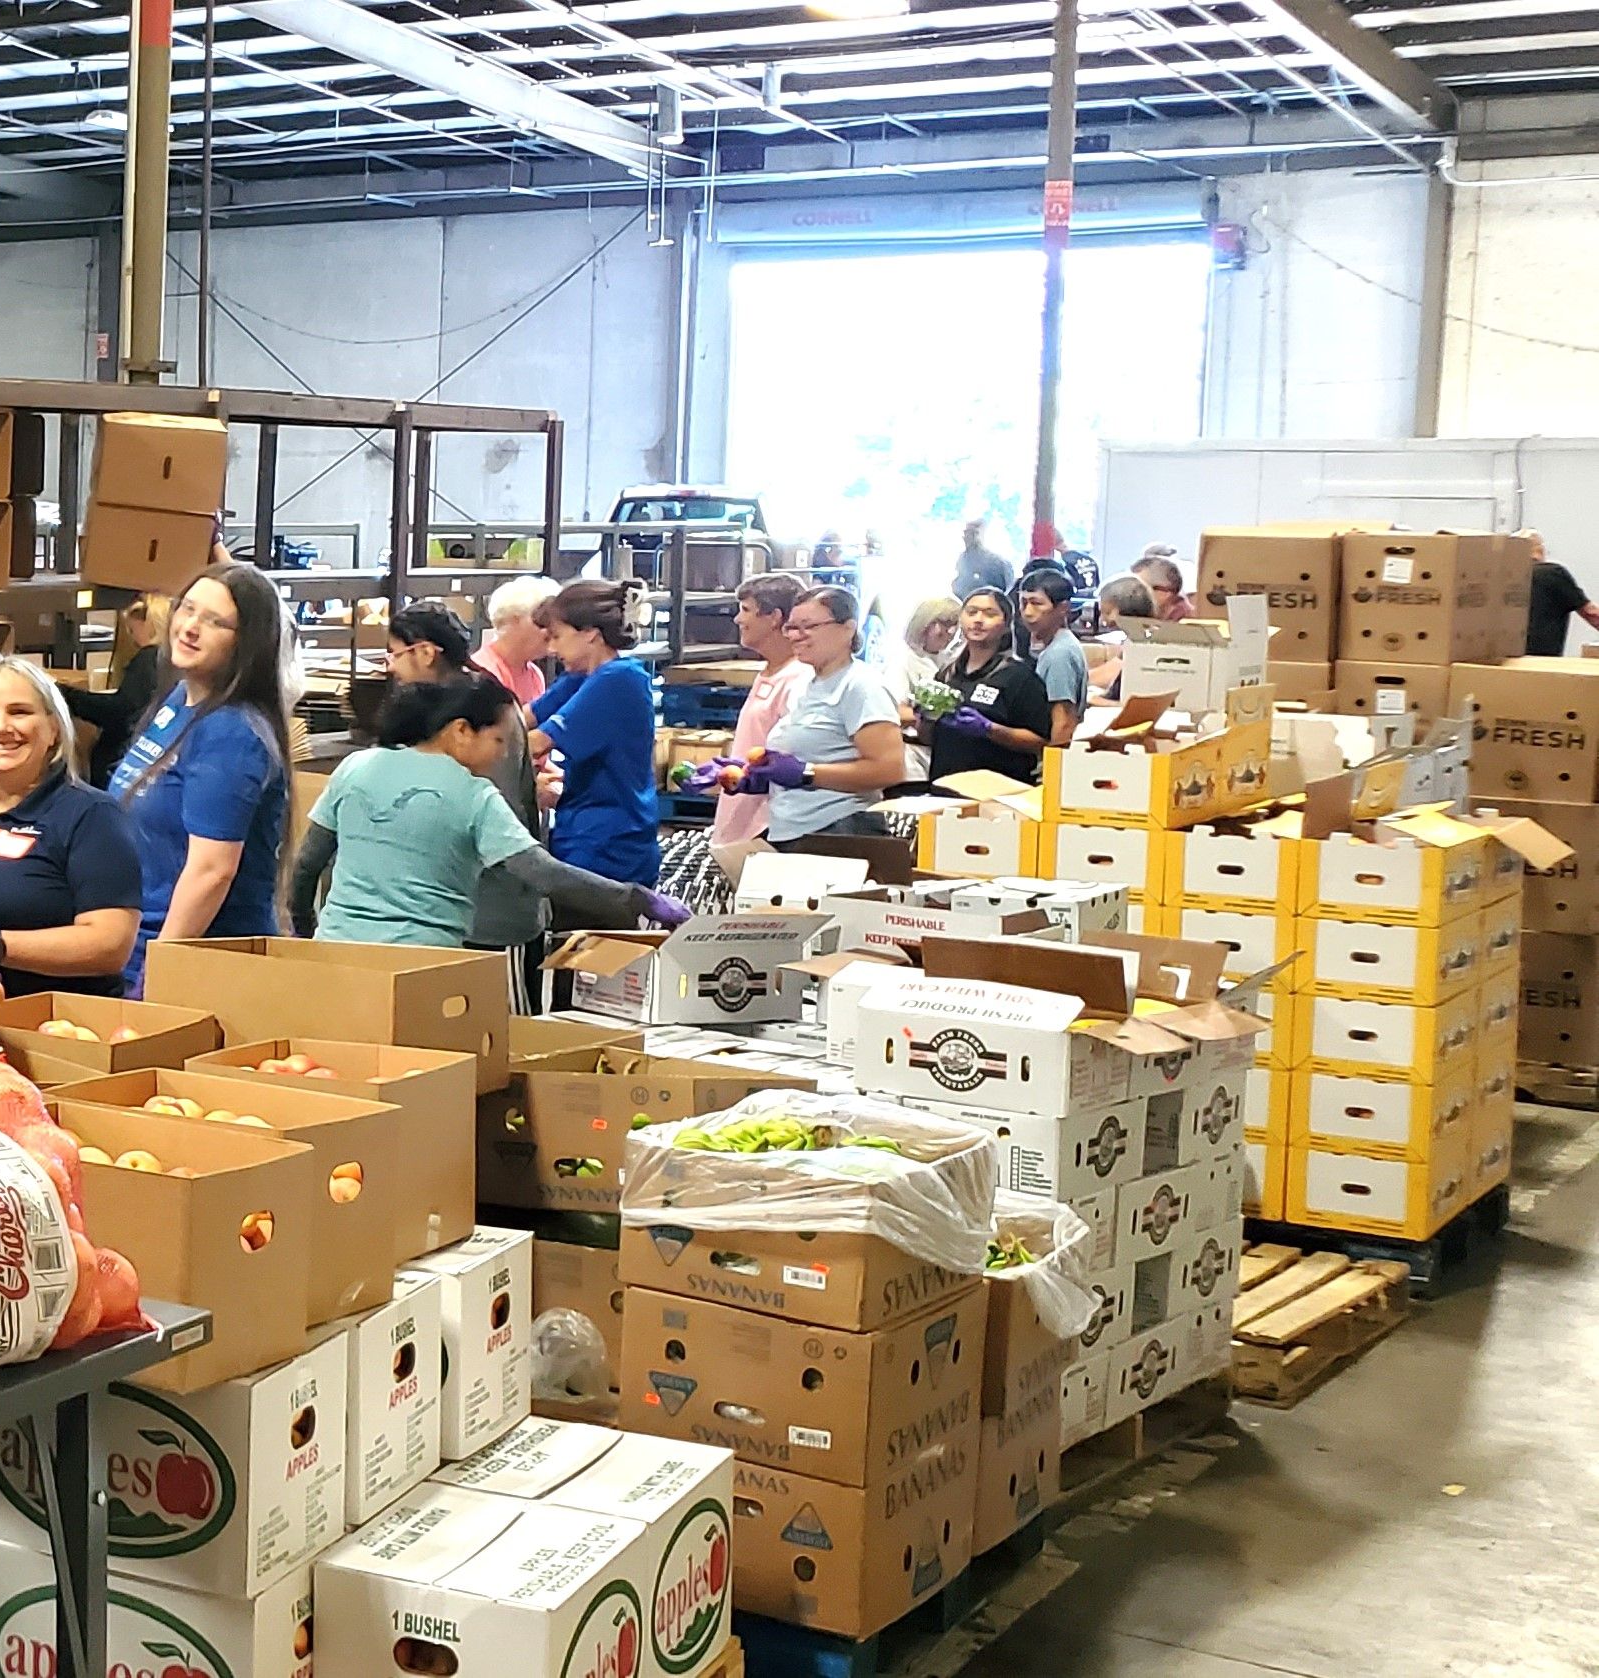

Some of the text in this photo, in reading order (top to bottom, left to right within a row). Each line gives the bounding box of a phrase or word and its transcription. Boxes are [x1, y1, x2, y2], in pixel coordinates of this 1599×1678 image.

[1236, 592, 1318, 609] ESH
[1376, 592, 1442, 605] FRESH
[1493, 727, 1585, 750] FRESH
[865, 933, 891, 944] KEEP
[885, 914, 946, 931] PERISHABLE
[688, 1274, 785, 1309] BANANAS
[882, 1266, 968, 1317] NANAS
[487, 1323, 511, 1355] APPLES
[389, 1373, 417, 1410] APPLES
[691, 1424, 790, 1461] BANANAS
[886, 1390, 972, 1466] BANANAS
[1, 1426, 153, 1499] aes
[285, 1442, 318, 1482] APPLES
[734, 1468, 790, 1495] ANAS
[884, 1450, 966, 1519] BANANAS
[656, 1553, 711, 1648] apples
[391, 1612, 462, 1643] 1 BUSHEL
